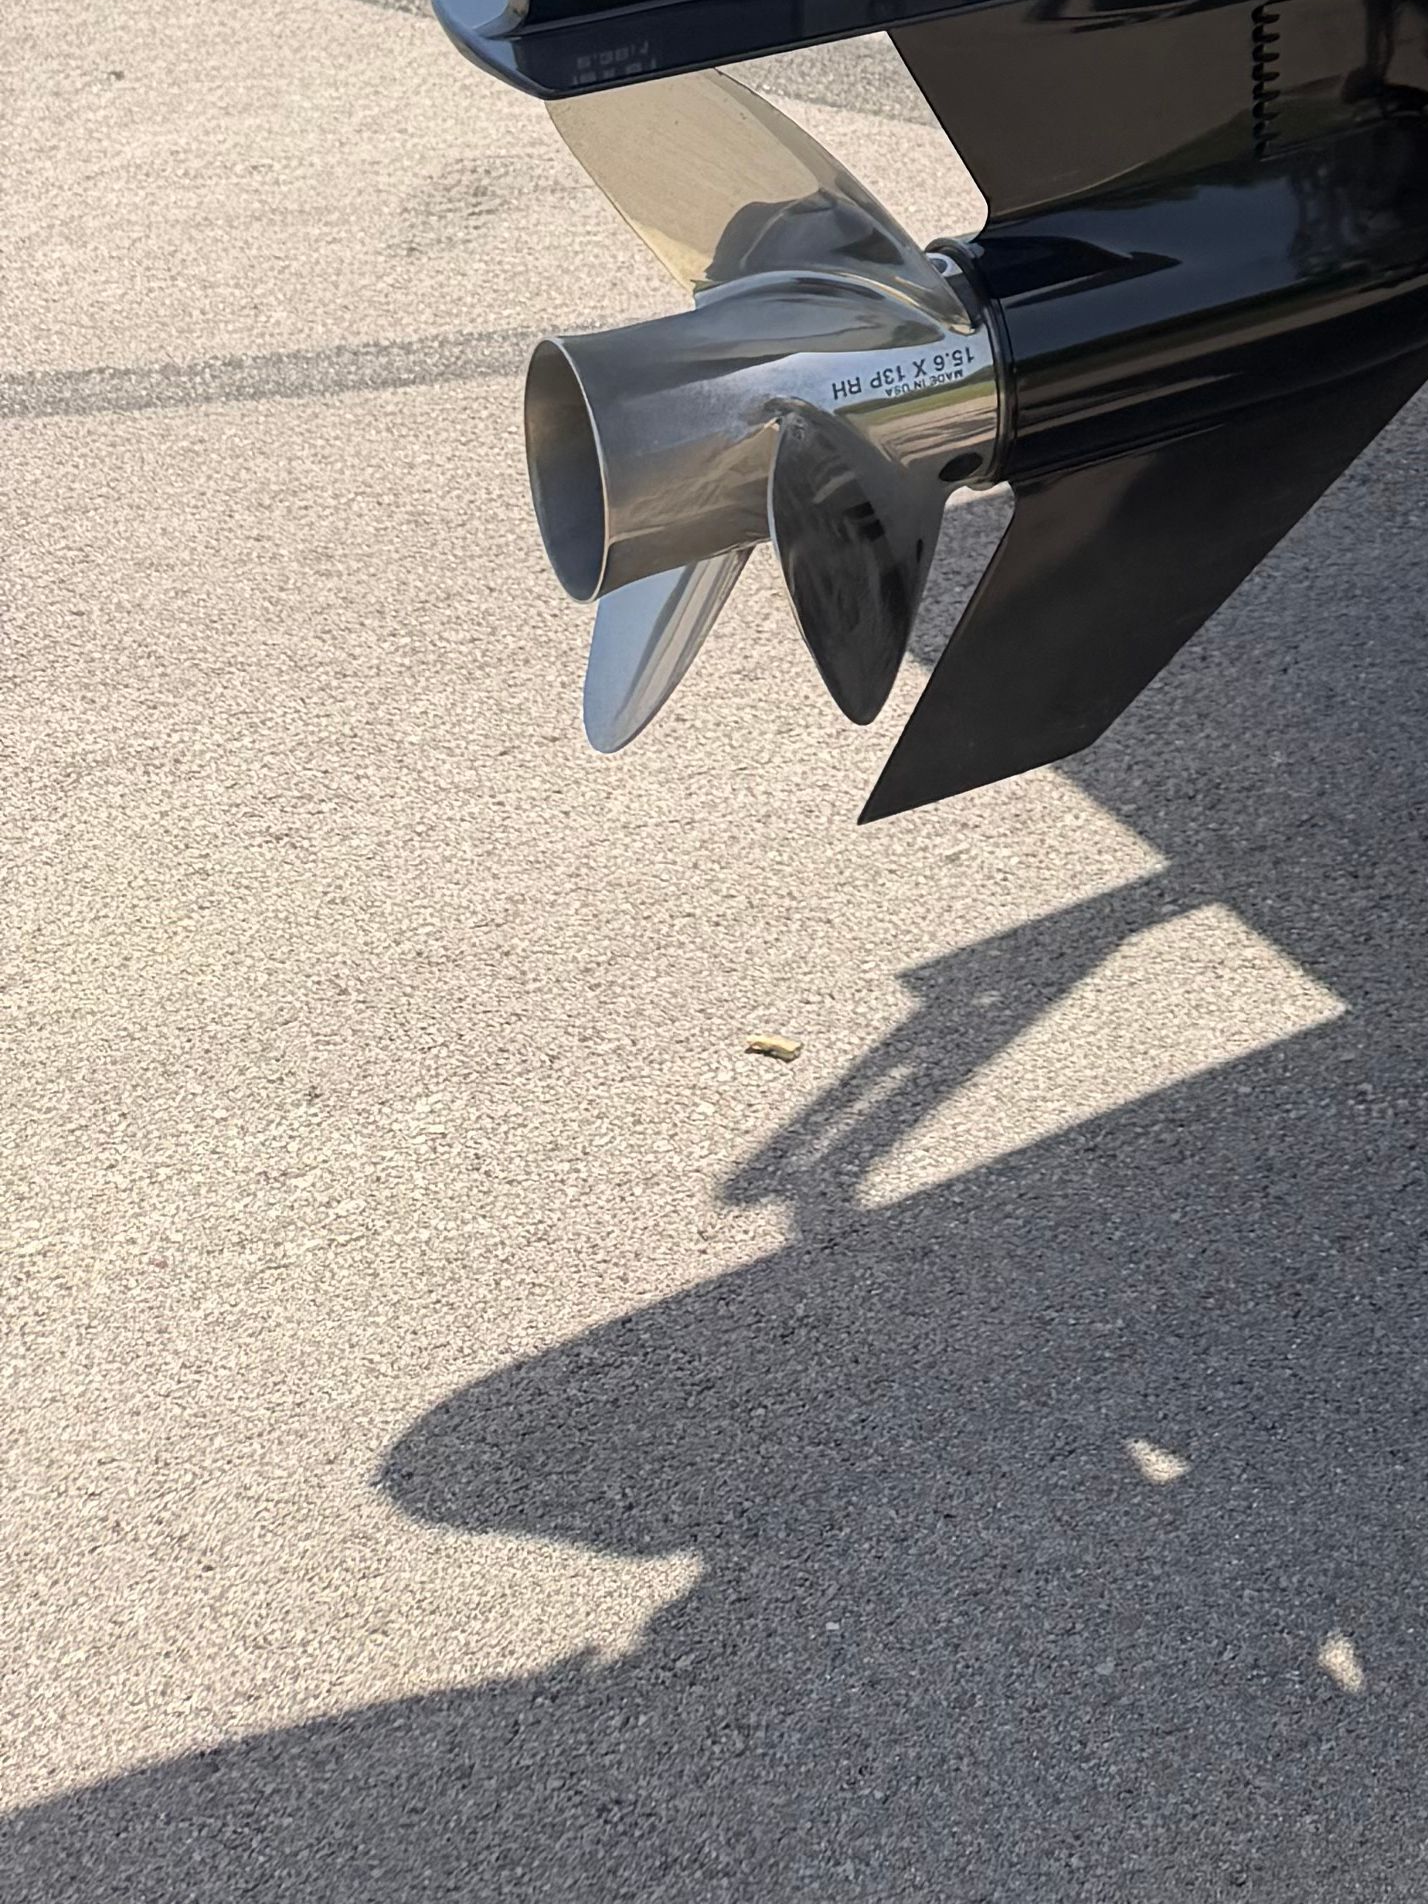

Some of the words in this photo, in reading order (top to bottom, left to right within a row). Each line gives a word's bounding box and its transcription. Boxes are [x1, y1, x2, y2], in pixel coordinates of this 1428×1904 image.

[912, 358, 927, 379] X
[933, 346, 975, 372] 15.6
[831, 376, 862, 400] RH
[869, 365, 906, 390] 13P
